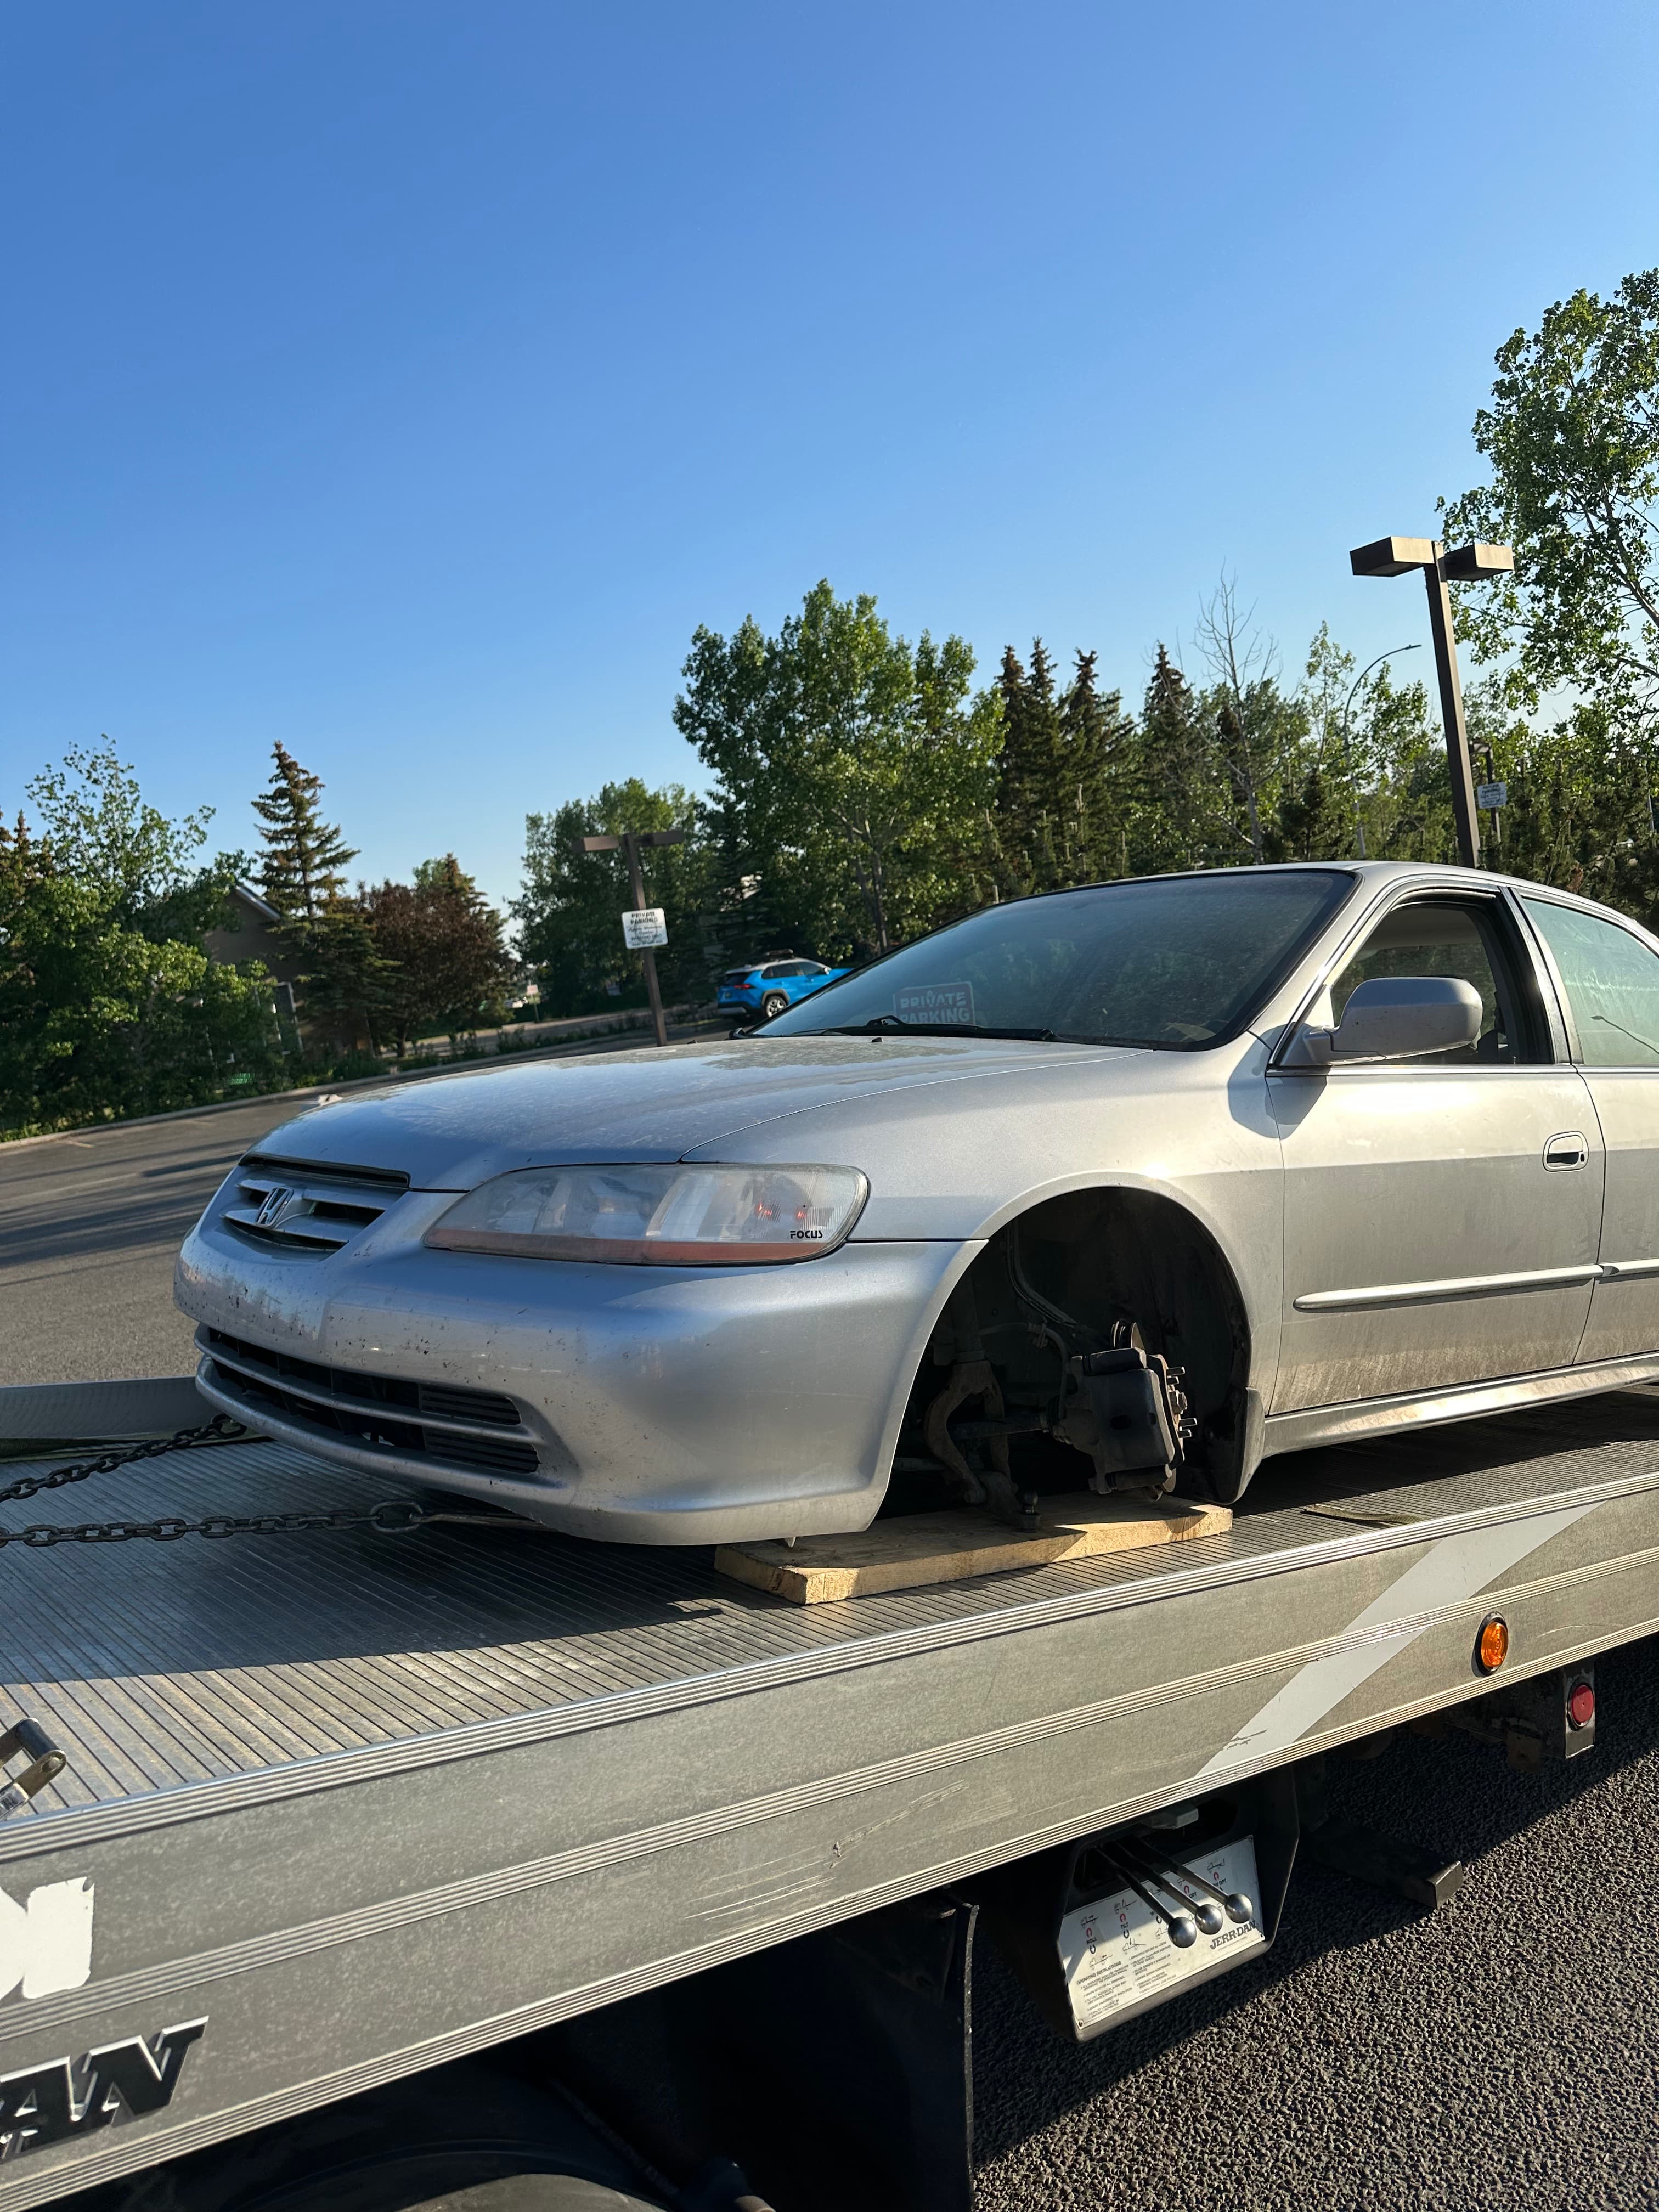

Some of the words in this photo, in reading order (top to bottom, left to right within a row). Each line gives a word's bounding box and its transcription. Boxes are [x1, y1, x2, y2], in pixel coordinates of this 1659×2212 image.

[900, 991, 966, 1009] PRIVATE
[900, 1007, 970, 1023] PARKING
[790, 1230, 823, 1239] FOCUS
[1077, 1973, 1096, 1984] OPERATING
[1097, 1961, 1122, 1976] INSTRUCTIONS
